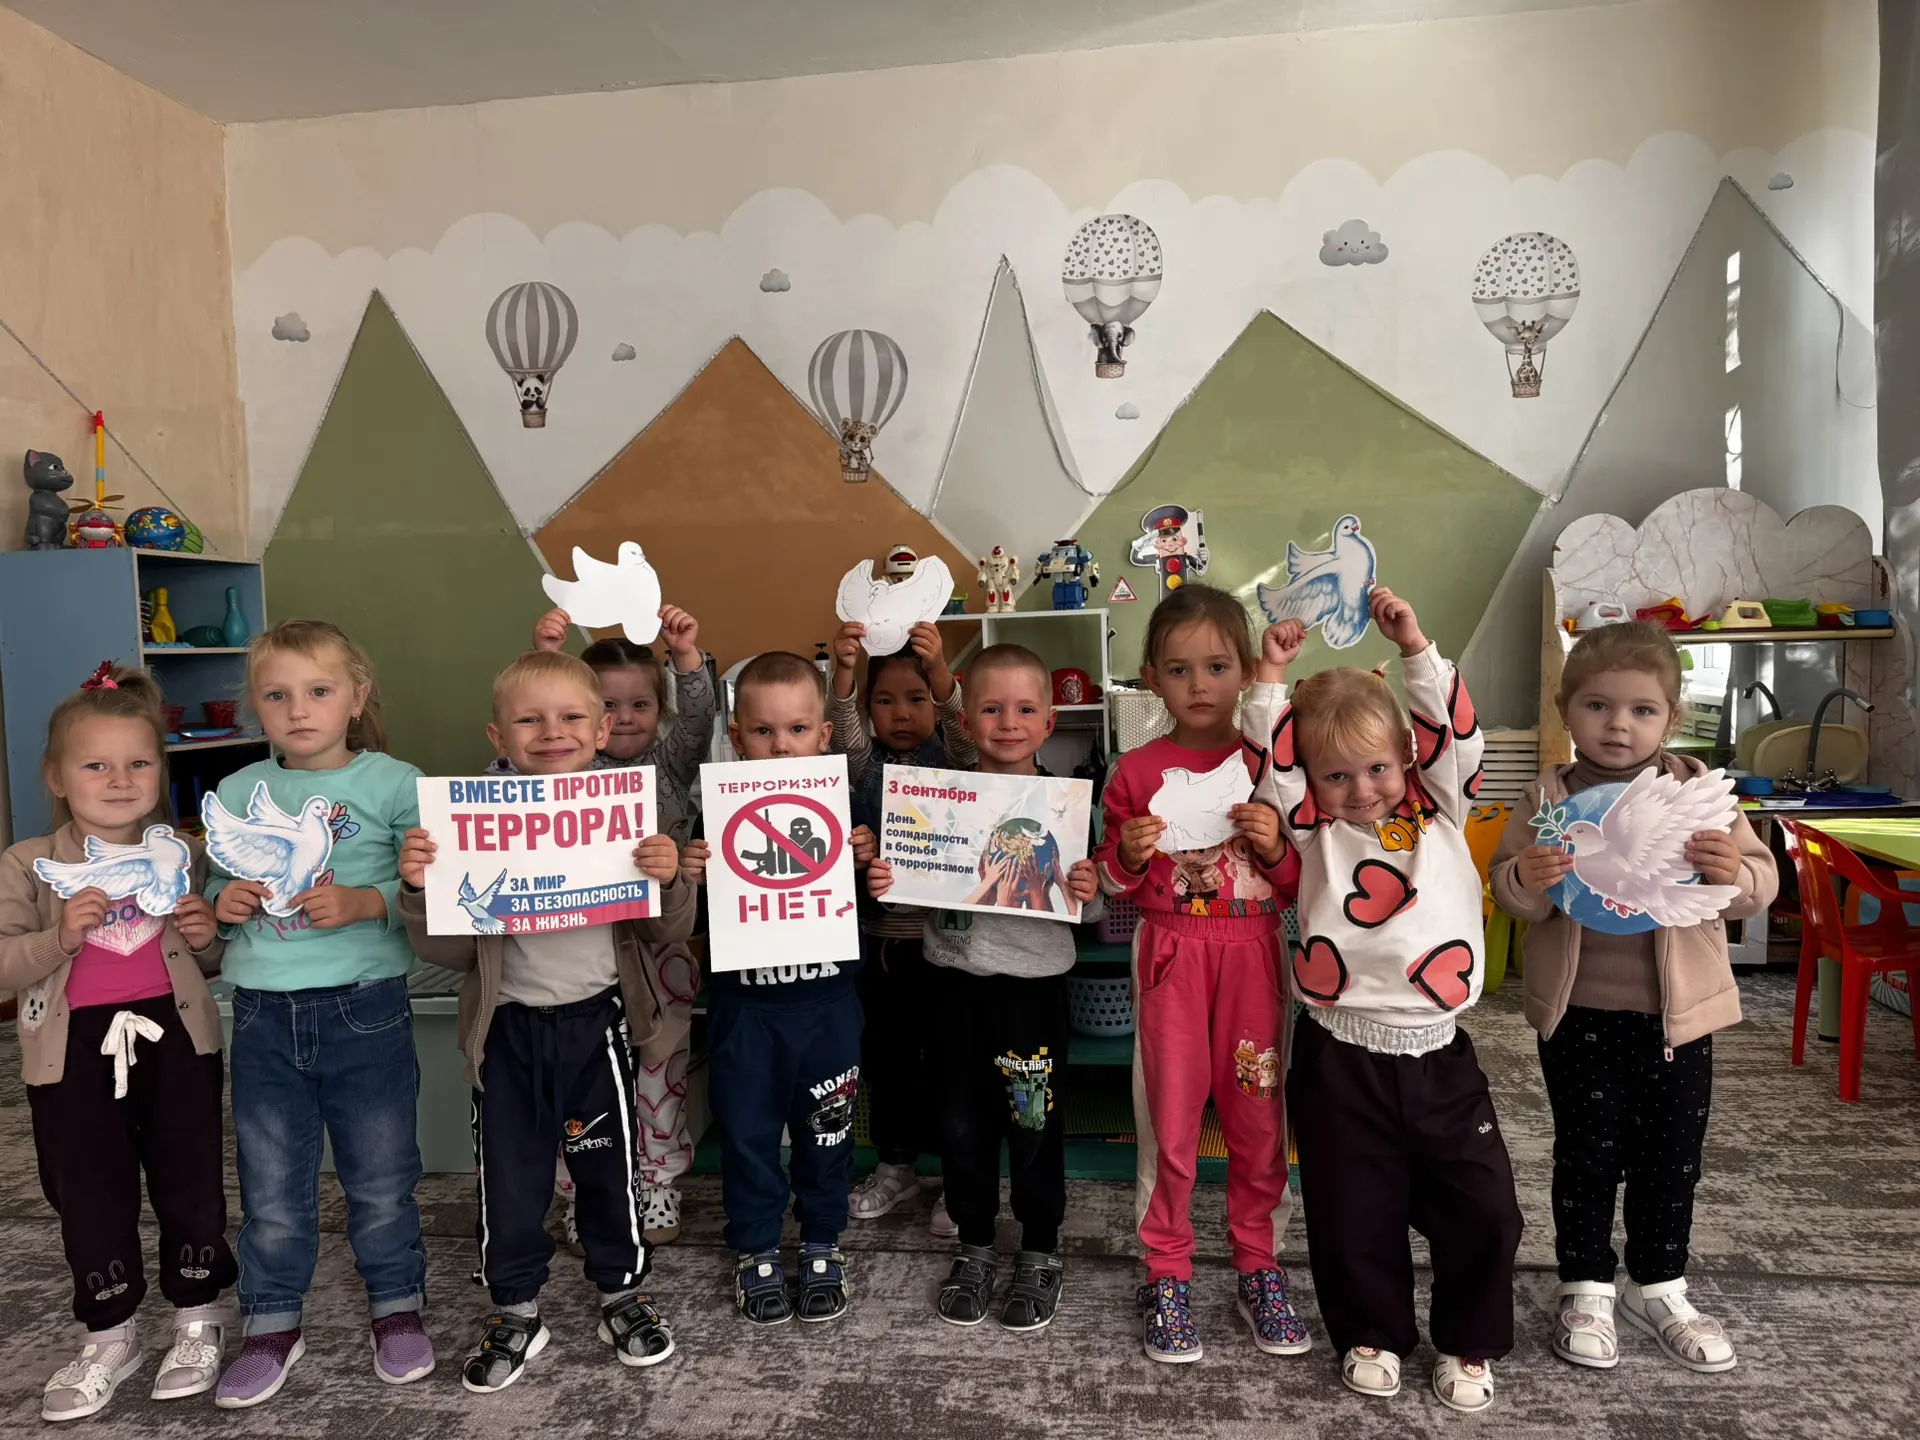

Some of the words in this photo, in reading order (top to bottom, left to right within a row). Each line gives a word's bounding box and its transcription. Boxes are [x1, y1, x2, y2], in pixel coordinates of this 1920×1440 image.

[448, 779, 545, 804] ВМЕСТЕ
[553, 771, 643, 801] ПРОТИВ
[718, 776, 840, 794] ТЕРРОРИЗМУ
[902, 783, 977, 803] сентября
[451, 802, 644, 851] ТЕРРОРА!
[886, 812, 916, 825] День
[886, 828, 969, 846] солидарности
[885, 842, 892, 851] в
[895, 841, 938, 857] борьбе
[893, 858, 974, 875] терроризмом
[510, 877, 529, 892] ЗА
[533, 874, 566, 890] МИР
[511, 898, 530, 912] ЗА
[534, 883, 643, 911] БЕЗОПАСНОСТЬ
[739, 889, 832, 923] НЕТ
[512, 918, 531, 932] ЗА
[535, 914, 588, 931] ЖИЗНЬ
[997, 1055, 1053, 1071] MINECRAFT
